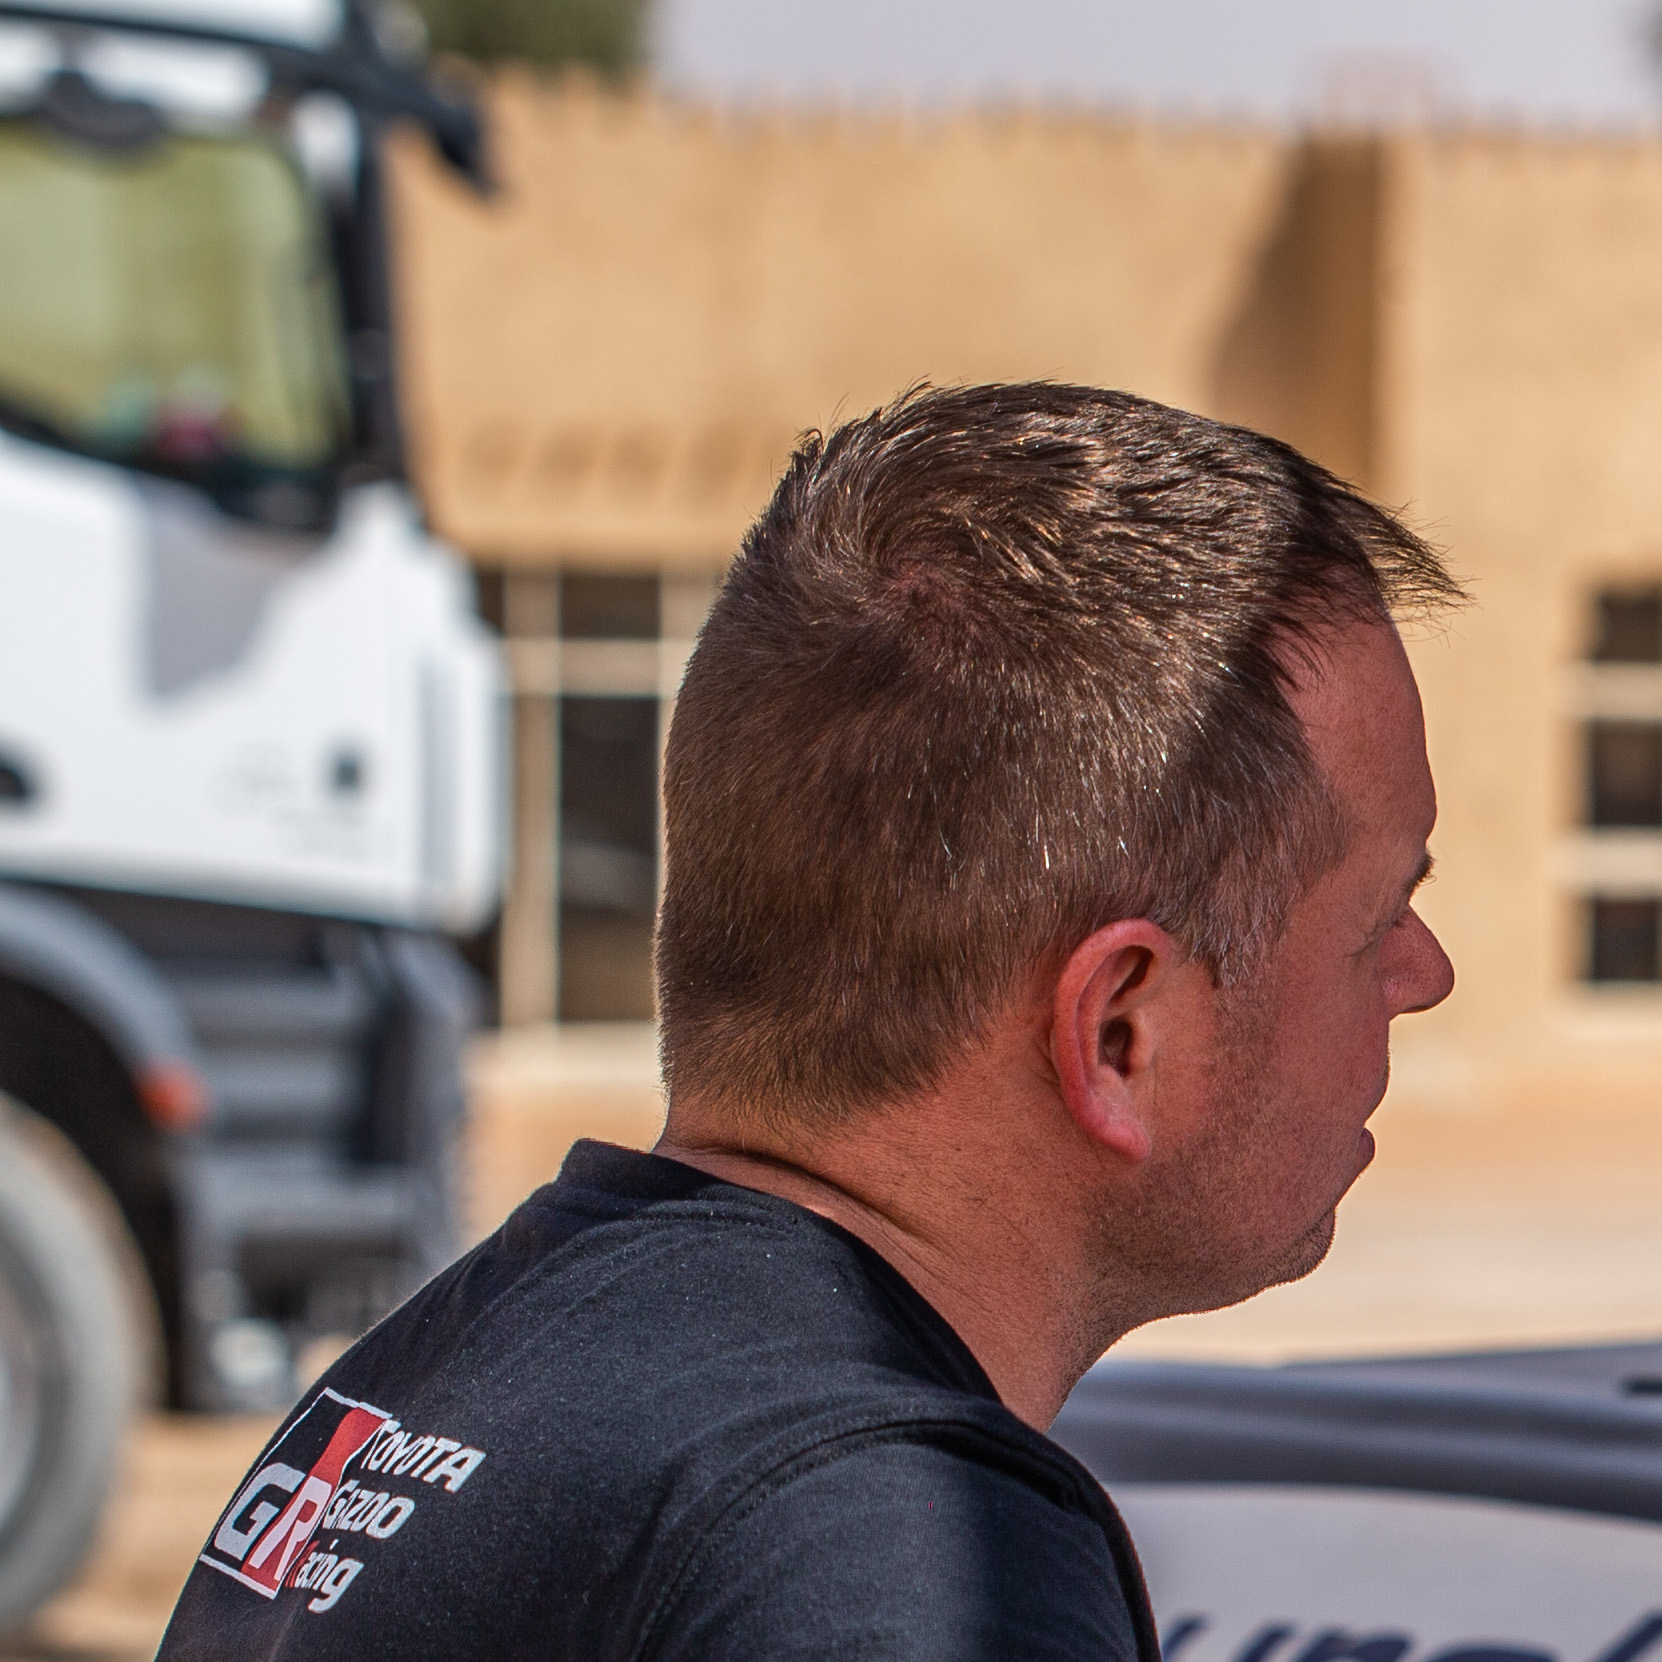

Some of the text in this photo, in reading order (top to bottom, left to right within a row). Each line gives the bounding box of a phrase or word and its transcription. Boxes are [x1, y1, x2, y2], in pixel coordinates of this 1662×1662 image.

[361, 1419, 487, 1493] TOYOTA
[213, 1462, 334, 1582] GR
[323, 1479, 415, 1540] GAZOO
